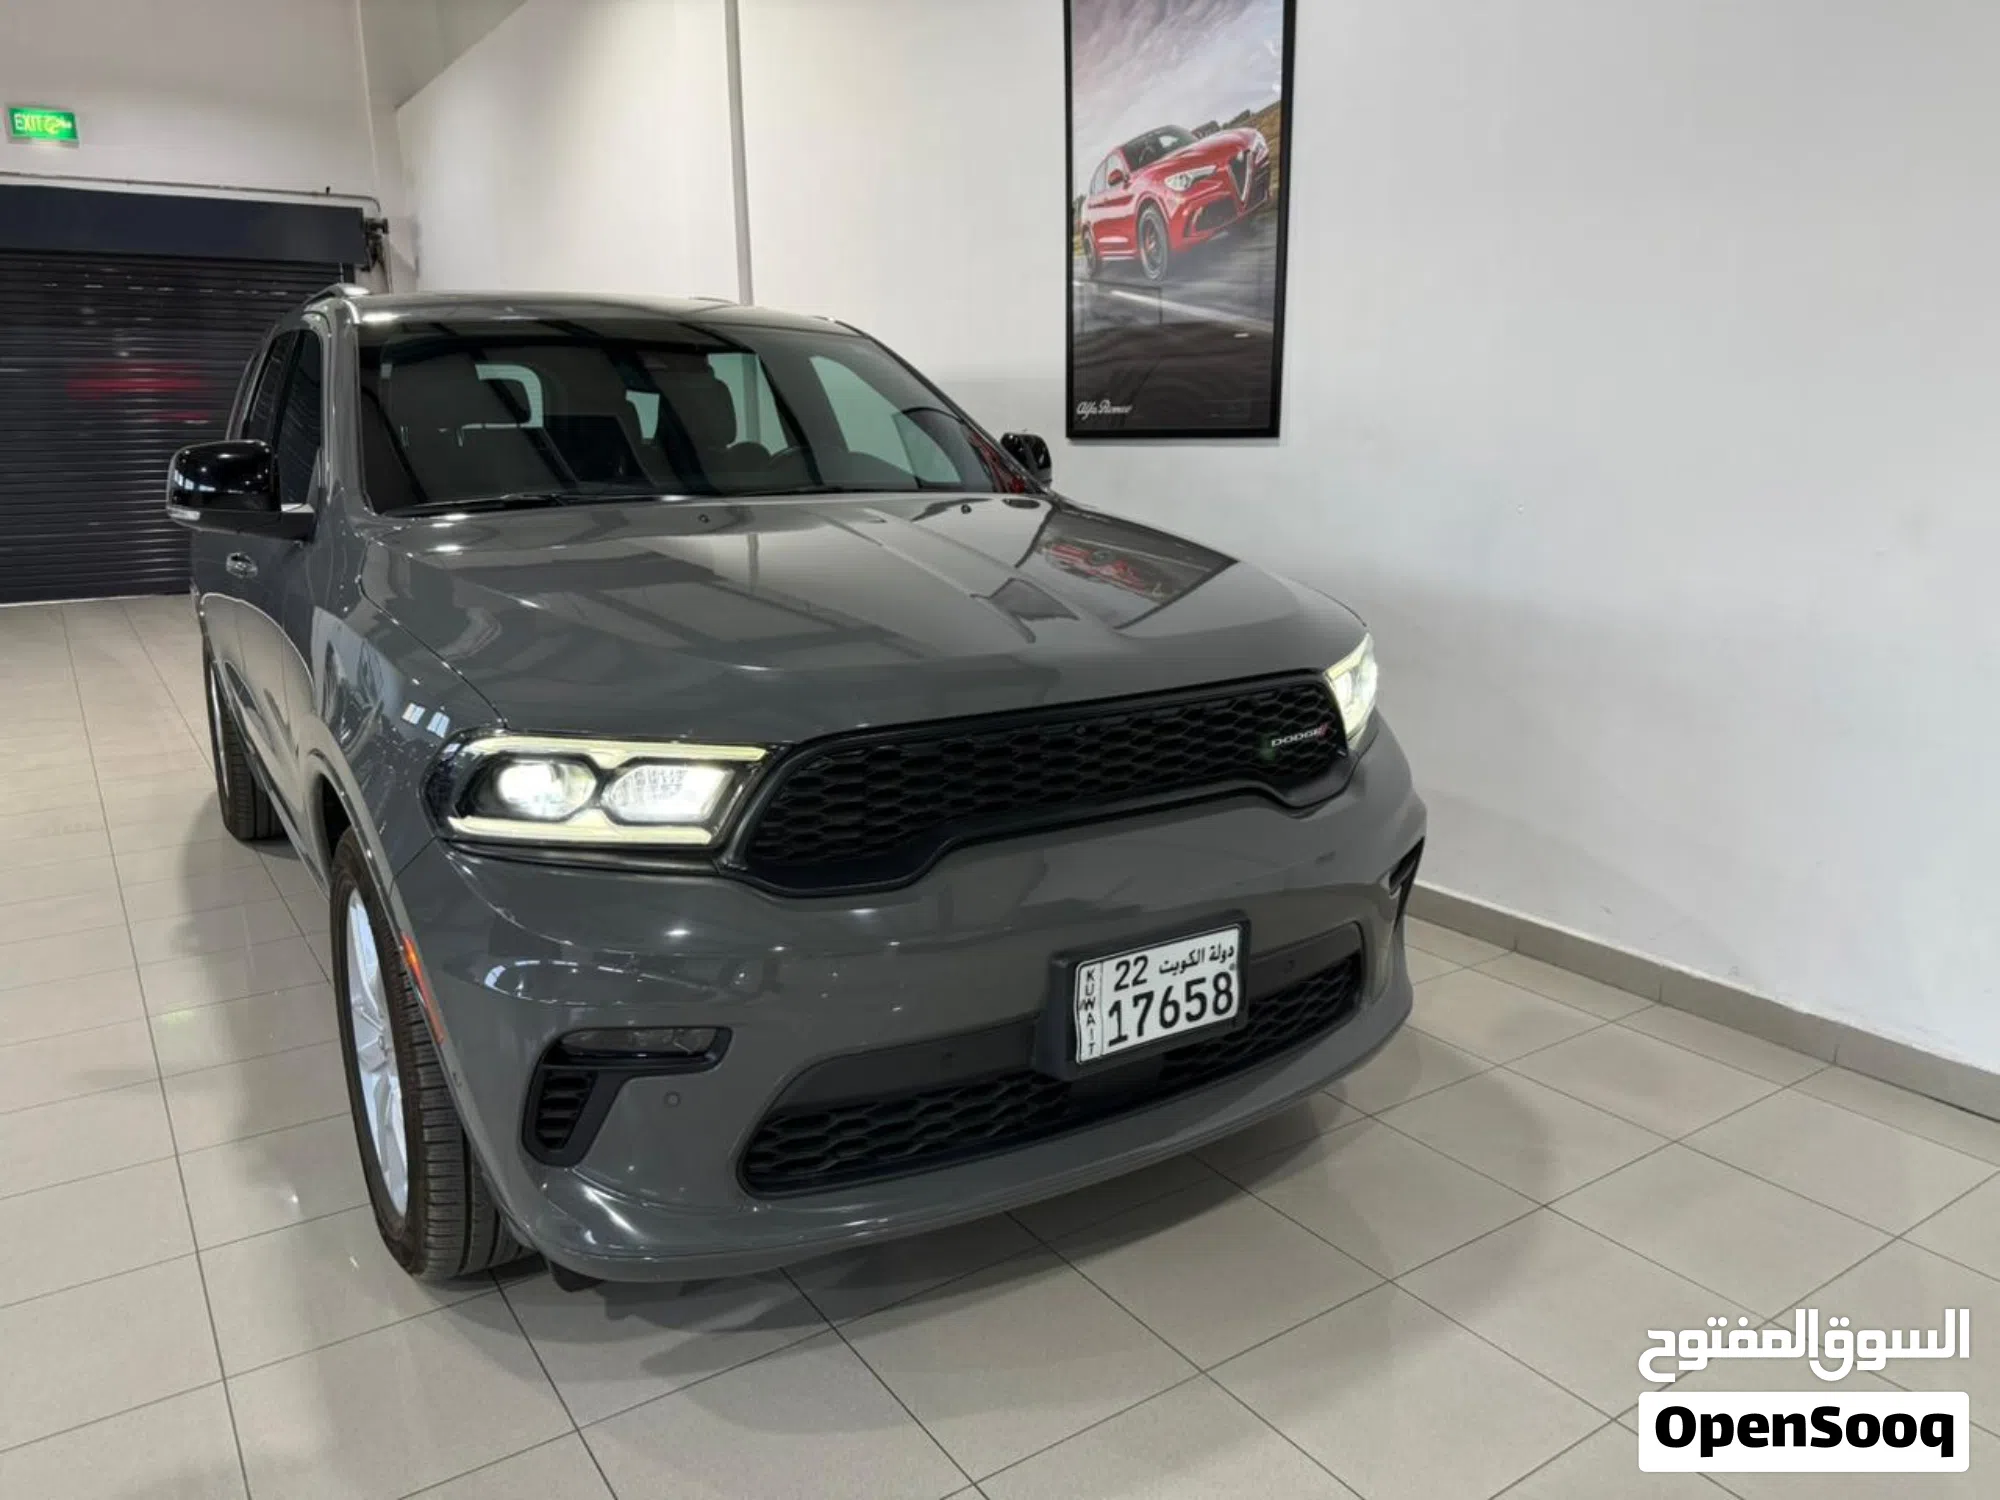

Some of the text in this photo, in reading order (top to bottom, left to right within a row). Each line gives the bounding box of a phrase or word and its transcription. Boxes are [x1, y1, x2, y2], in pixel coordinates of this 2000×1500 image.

[14, 113, 44, 132] EXIT
[1076, 401, 1097, 420] Alfa
[1271, 728, 1320, 747] DODGE
[1114, 955, 1149, 992] 22
[1159, 942, 1234, 976] دولة الكويت
[1084, 969, 1096, 1056] KUWAIT
[1108, 971, 1233, 1047] 17658
